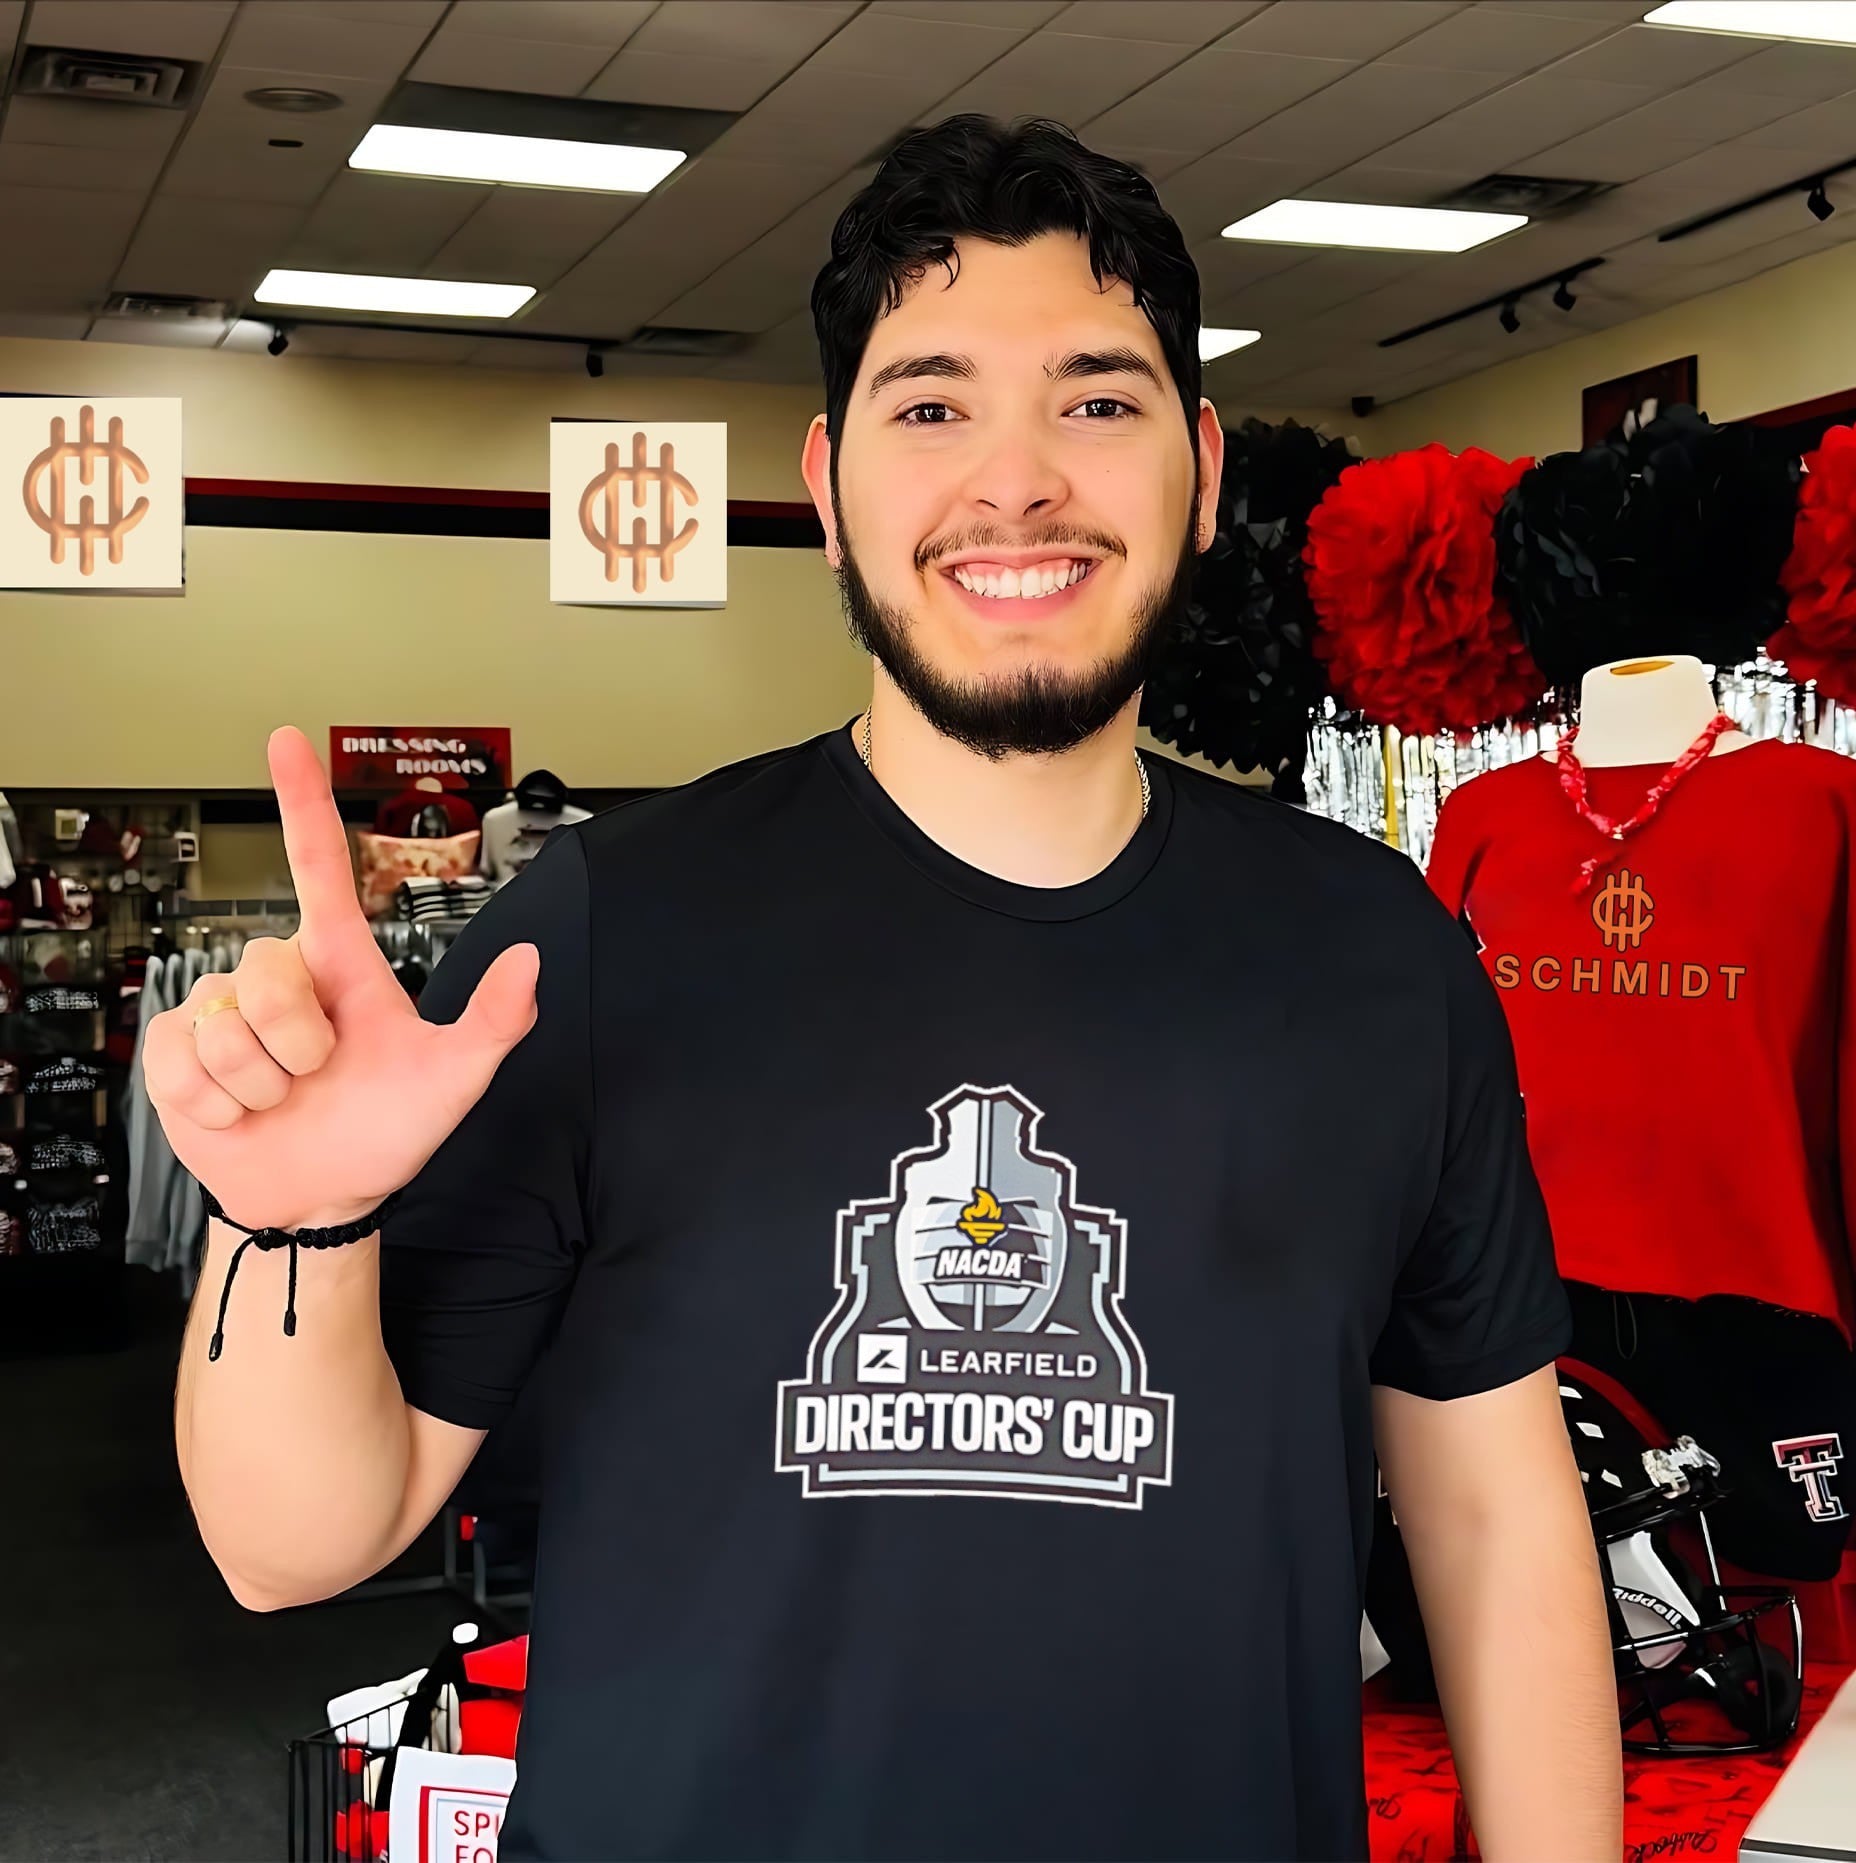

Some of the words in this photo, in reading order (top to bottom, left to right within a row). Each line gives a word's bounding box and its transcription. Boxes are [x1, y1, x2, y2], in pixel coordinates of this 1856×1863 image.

[396, 758, 487, 774] ROOMS
[1494, 954, 1747, 1000] SCHMIDT
[936, 1248, 1022, 1279] NACDA
[920, 1349, 1098, 1377] LEARFIELD
[794, 1391, 1054, 1456] DIRECTORS'
[1062, 1399, 1155, 1464] CUP
